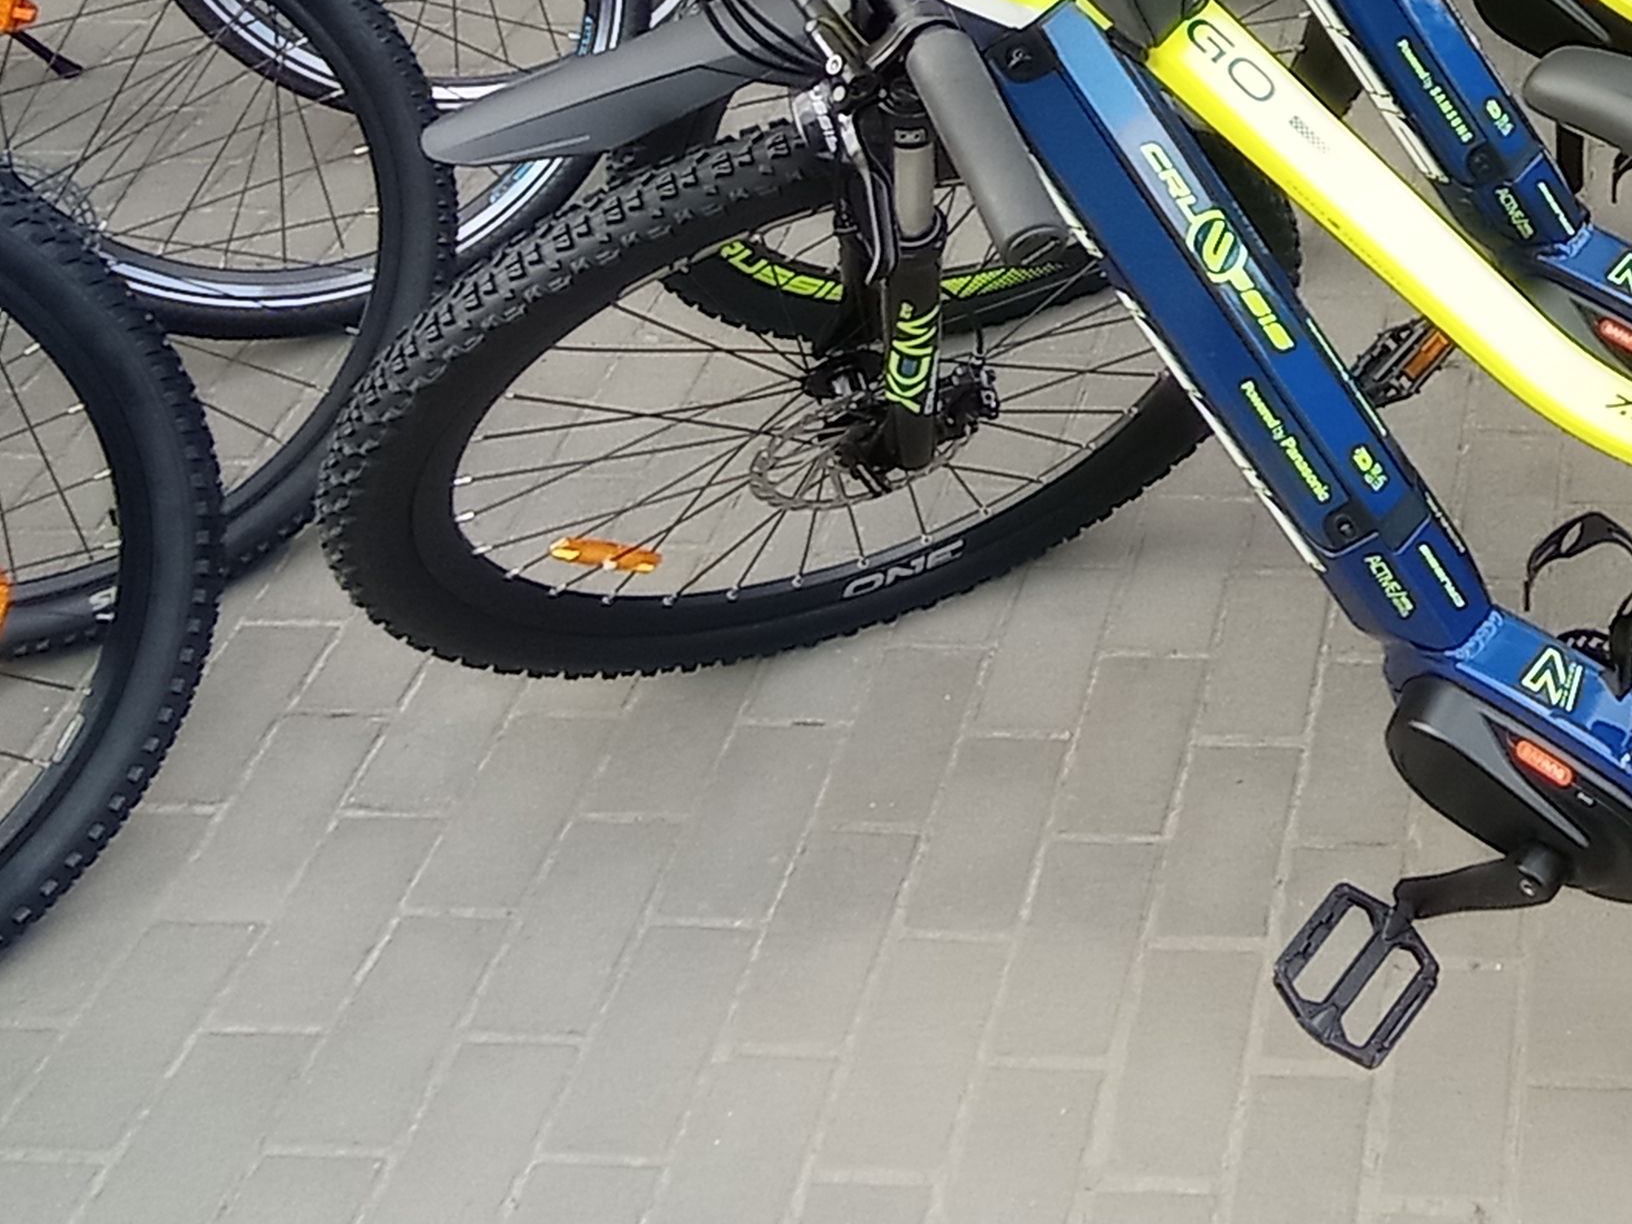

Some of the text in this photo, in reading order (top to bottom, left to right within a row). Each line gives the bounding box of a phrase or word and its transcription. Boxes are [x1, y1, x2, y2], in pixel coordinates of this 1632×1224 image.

[1429, 86, 1473, 143] SAMSUNG
[1241, 380, 1283, 429] Powered
[1281, 436, 1330, 502] Panasonic
